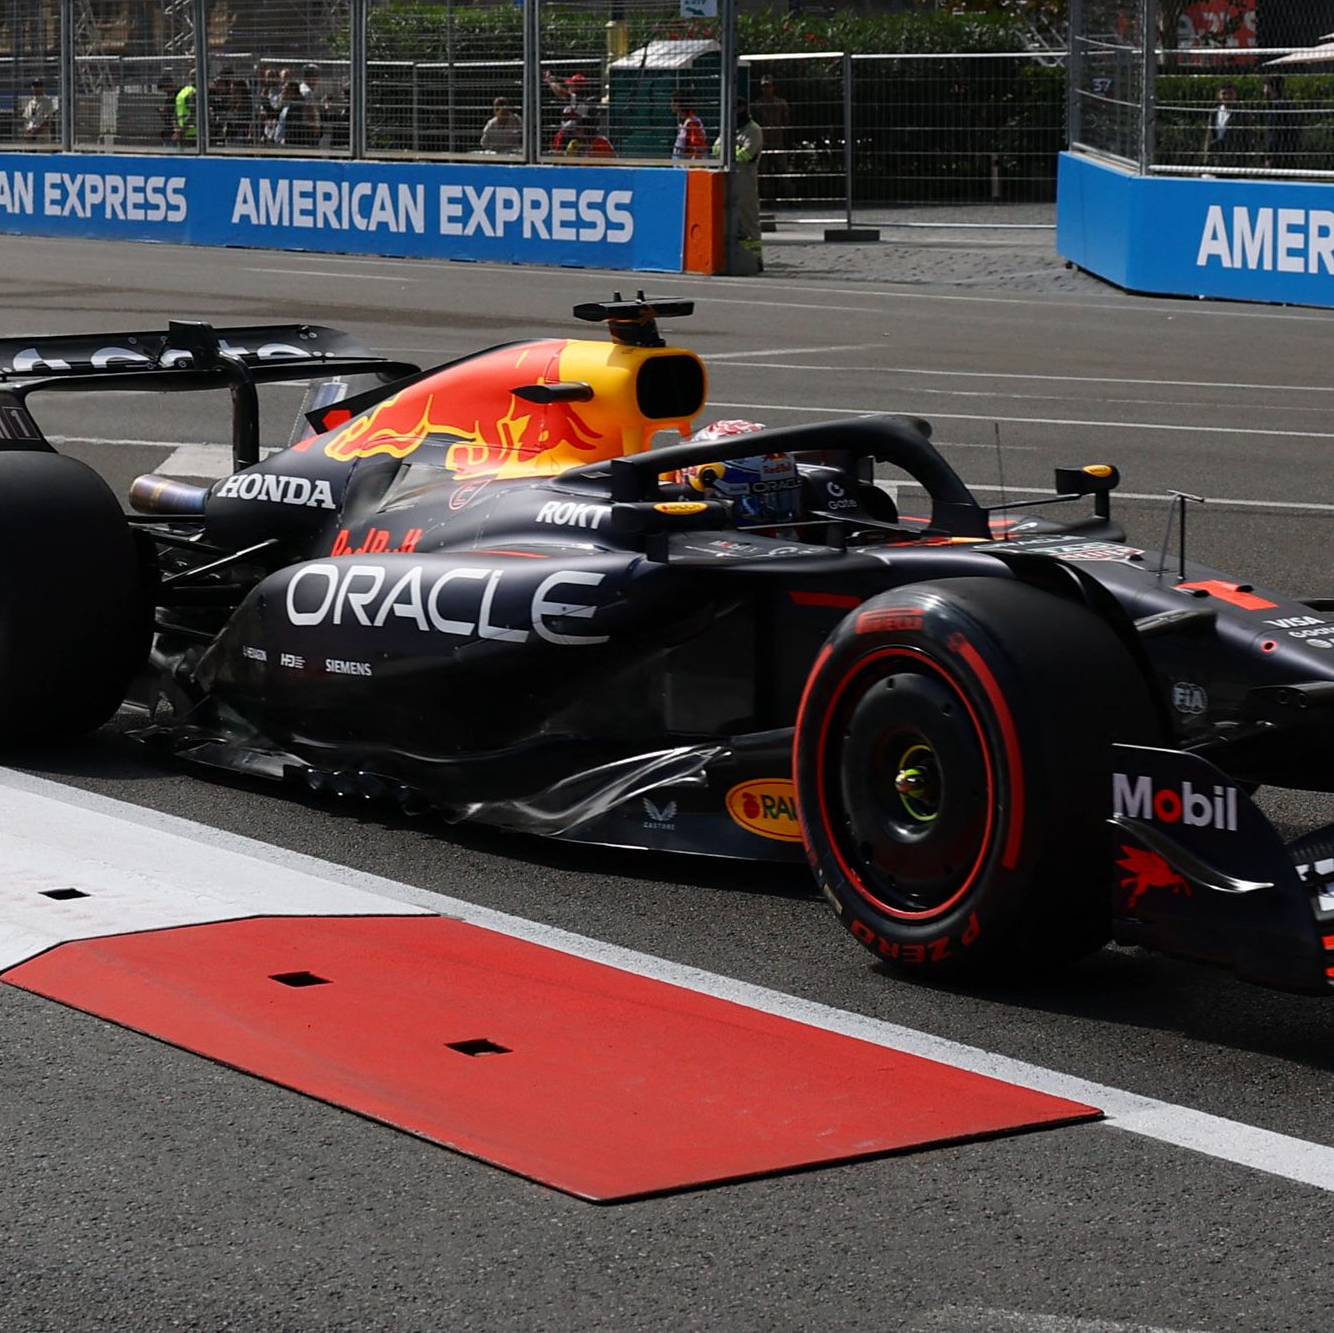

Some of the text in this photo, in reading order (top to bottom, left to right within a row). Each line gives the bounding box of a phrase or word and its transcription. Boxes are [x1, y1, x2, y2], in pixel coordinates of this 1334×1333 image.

[43, 173, 187, 223] EXPRESS
[231, 176, 635, 244] AMERICAN EXPRESS
[216, 472, 337, 510] HONDA
[535, 500, 612, 530] ROKT
[286, 563, 611, 646] ORACLE
[1263, 615, 1326, 629] VISA
[325, 658, 372, 676] SIEMENS
[1112, 772, 1238, 832] Mobil
